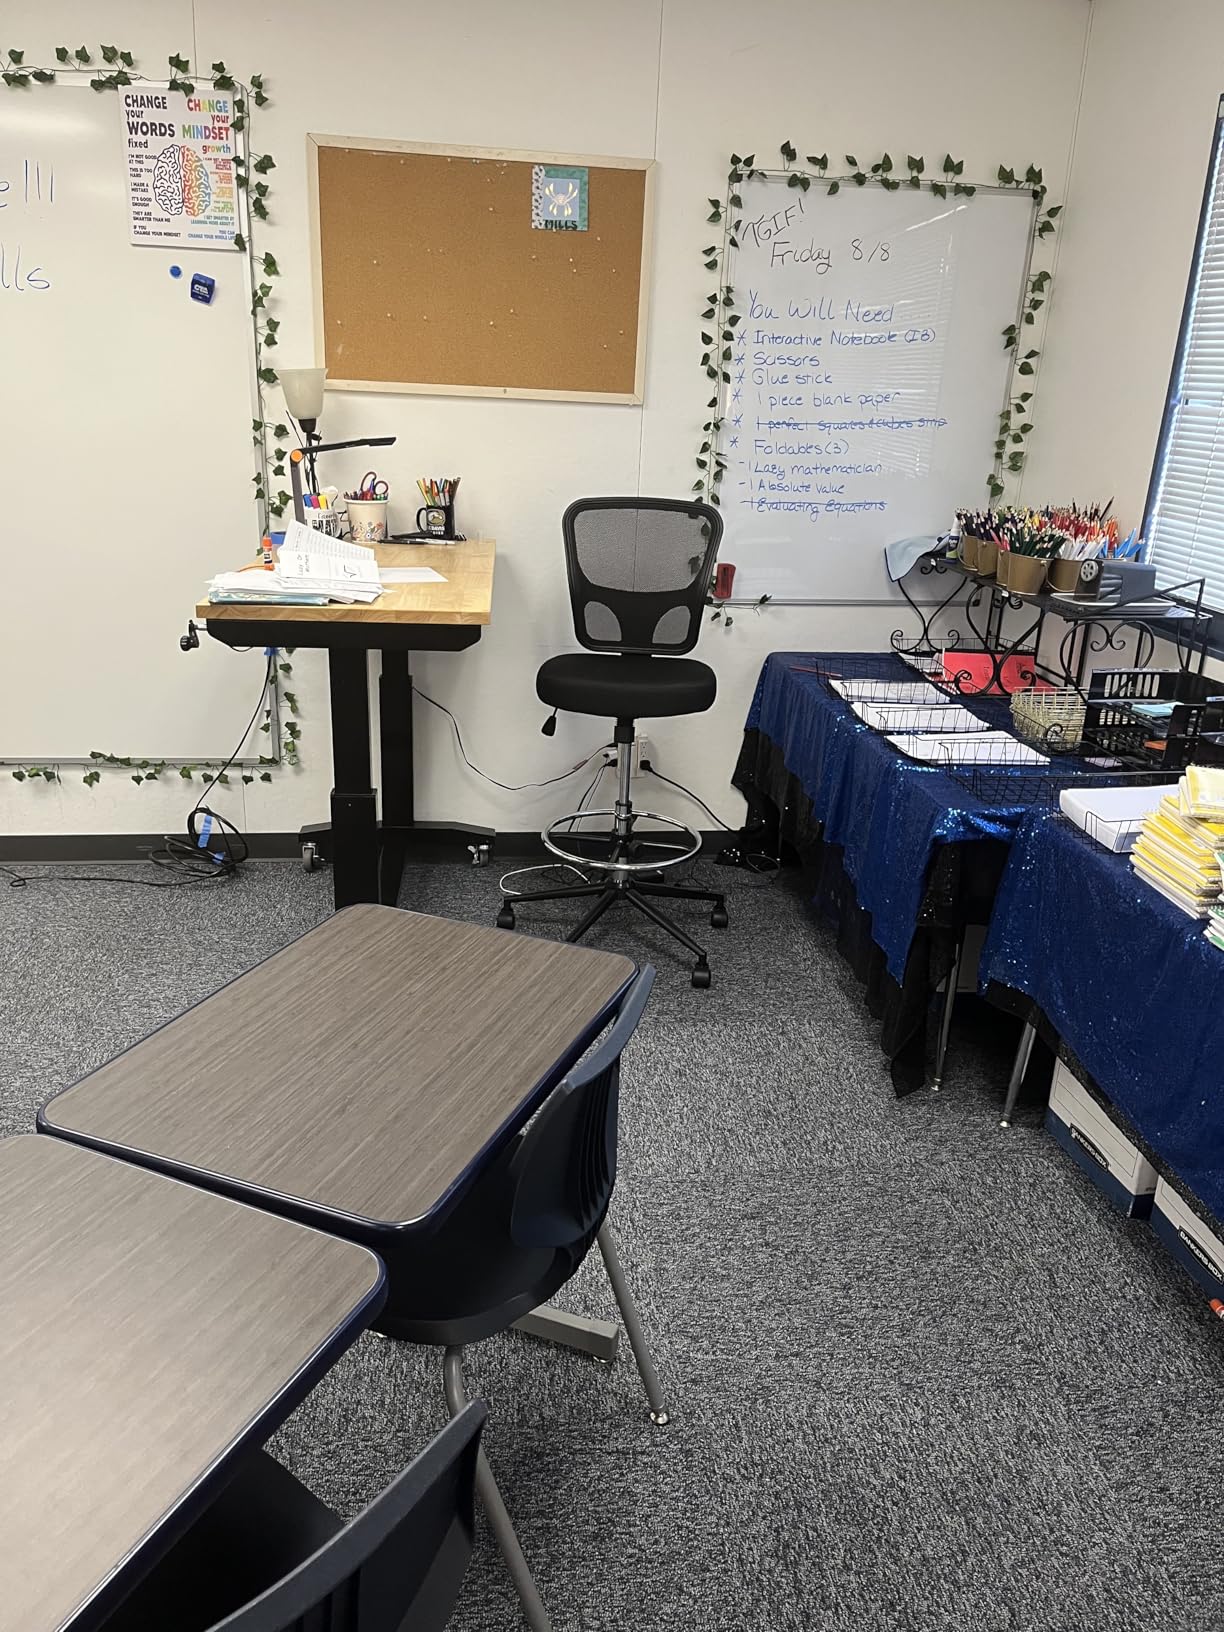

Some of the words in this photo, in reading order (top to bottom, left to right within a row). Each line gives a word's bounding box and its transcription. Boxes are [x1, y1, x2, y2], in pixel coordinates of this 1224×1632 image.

[124, 95, 167, 109] CHANGE
[187, 98, 228, 113] CHANGE
[126, 109, 144, 120] your
[211, 114, 229, 125] your
[127, 121, 175, 137] WORDS
[183, 125, 230, 141] MINDSET
[128, 138, 148, 149] fixed
[202, 144, 231, 154] growth
[544, 219, 578, 230] MILLS
[742, 198, 805, 247] TGIF!
[771, 238, 832, 275] Friday
[851, 238, 891, 264] 8/8
[749, 289, 779, 320] You
[788, 297, 834, 321] Will
[845, 299, 895, 323] Need
[753, 330, 822, 347] Interactive
[830, 329, 897, 346] Notebook
[753, 351, 820, 367] Scissors
[751, 368, 790, 386] Glue
[795, 370, 833, 385] stick
[768, 395, 804, 413] piece
[812, 391, 853, 408] blank
[858, 391, 902, 412] paper
[754, 463, 786, 480] Lazy
[791, 462, 883, 476] mathematician
[758, 479, 811, 494] Absolute
[757, 498, 820, 521] Evaluating
[824, 499, 888, 518] Equations
[1179, 1230, 1209, 1265] BANKERS
[1207, 1261, 1223, 1281] BOX
